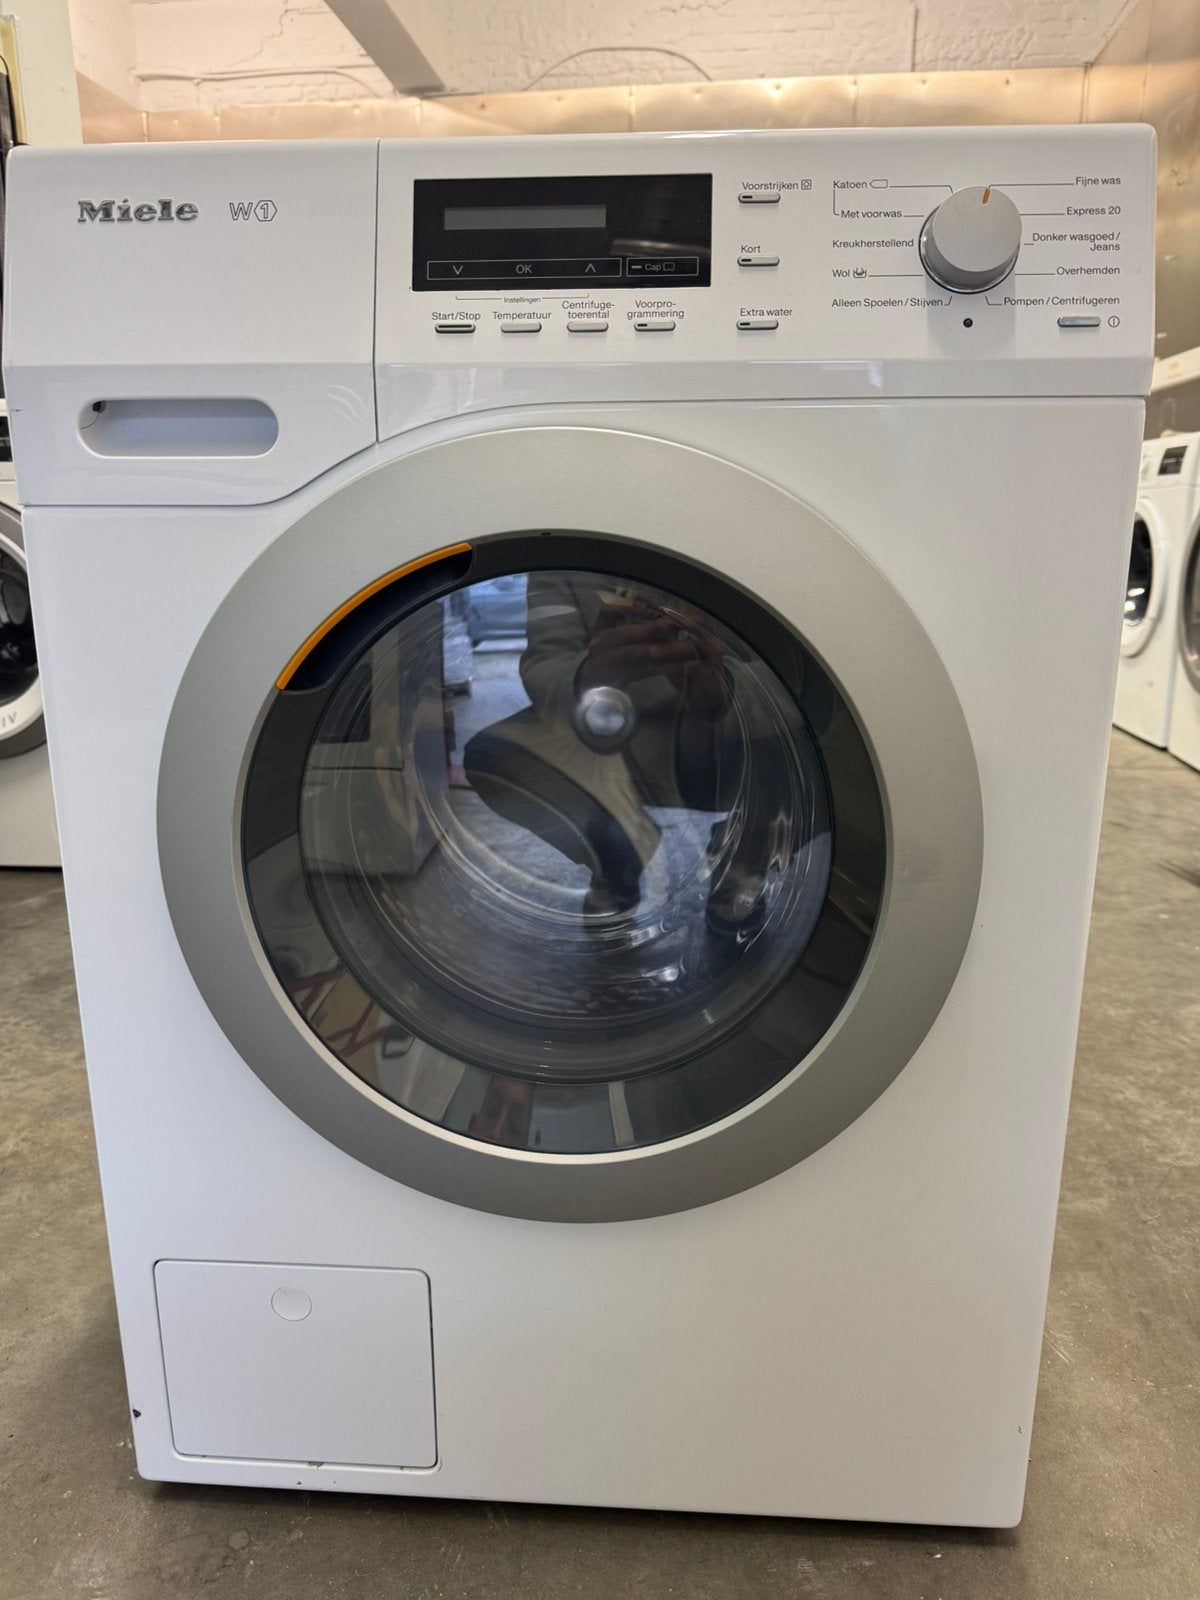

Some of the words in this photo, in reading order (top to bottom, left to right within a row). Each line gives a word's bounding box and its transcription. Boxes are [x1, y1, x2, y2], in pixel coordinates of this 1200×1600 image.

[741, 181, 799, 192] Voorstrijken
[833, 180, 867, 190] Katoen
[1075, 176, 1100, 188] Fijne
[1101, 177, 1121, 186] was
[77, 198, 199, 223] Miele
[840, 210, 859, 219] Met
[861, 210, 903, 219] voorwas
[1066, 206, 1106, 217] Express
[1108, 205, 1121, 215] 20
[1032, 232, 1067, 242] Donker
[832, 238, 914, 249] Kreukherstellend
[1089, 242, 1121, 252] Jeans
[740, 244, 762, 254] Kort
[515, 264, 533, 274] OK
[645, 263, 662, 272] Cap
[1056, 266, 1121, 276] Overhemden
[832, 268, 850, 278] Wol
[503, 296, 541, 305] Instellingen
[635, 300, 677, 311] Voorpro-
[831, 297, 862, 308] Alleen
[863, 298, 904, 309] Spoelen
[909, 297, 943, 308] Stijven
[1003, 296, 1045, 307] Pompen
[1051, 295, 1120, 307] Centrifugeren
[561, 300, 615, 312] Centrifuge-
[431, 311, 482, 322] Start/Stop
[492, 311, 552, 321] Temperatuur
[567, 309, 610, 319] toerental
[627, 309, 685, 320] grammering
[739, 308, 764, 317] Extra
[765, 308, 793, 317] water
